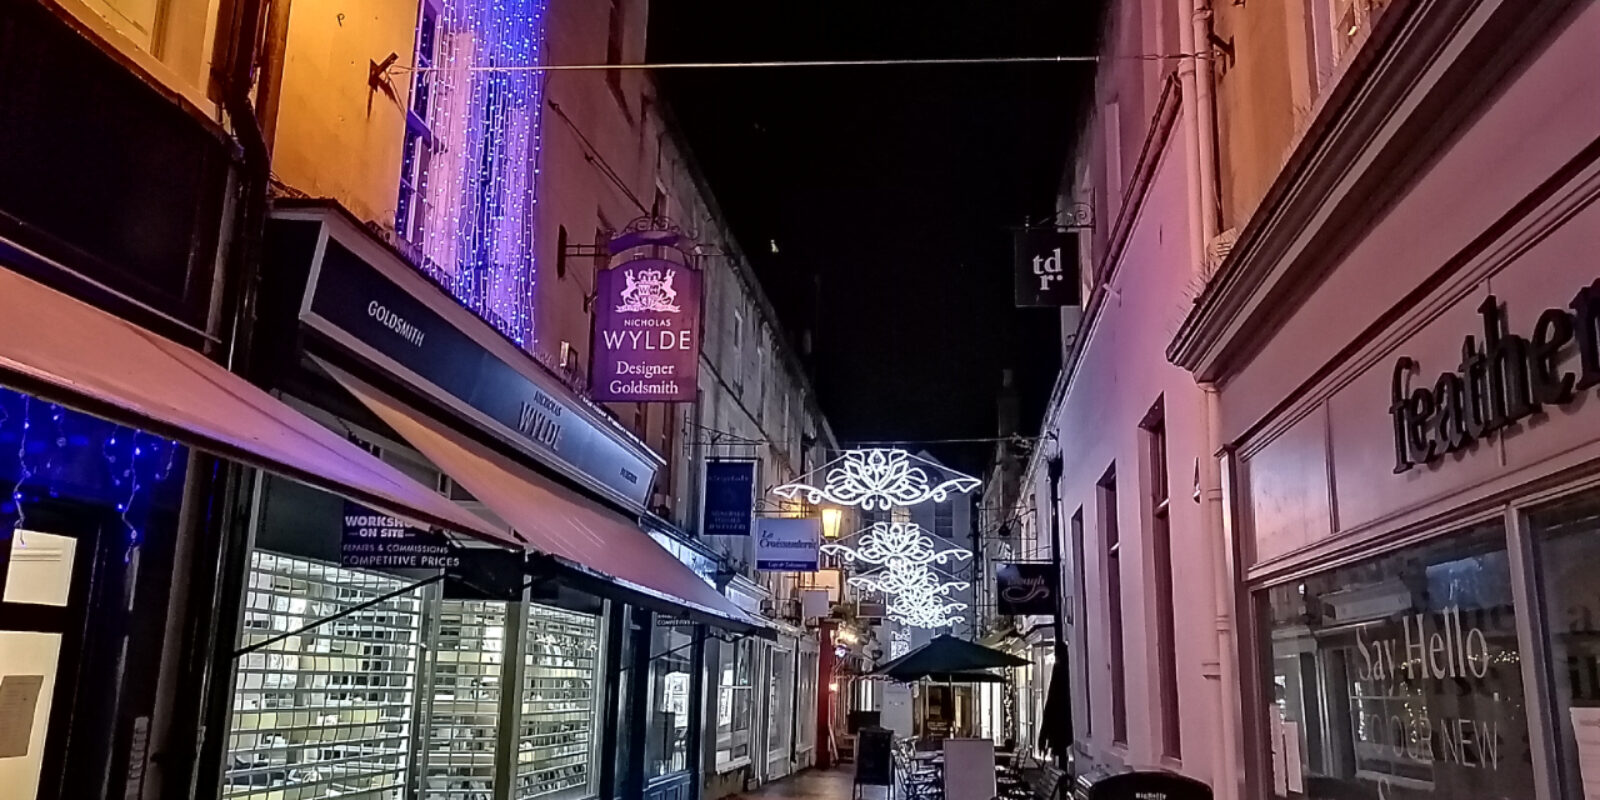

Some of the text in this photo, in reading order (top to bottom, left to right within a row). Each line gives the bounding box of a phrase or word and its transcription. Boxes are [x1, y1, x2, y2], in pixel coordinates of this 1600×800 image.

[1033, 248, 1063, 275] td
[368, 300, 425, 347] GOLDSMITH
[624, 319, 671, 327] NICHOLAS
[603, 330, 691, 350] WYLDE
[616, 361, 674, 378] Designer
[610, 380, 678, 394] Goldsmith
[518, 401, 562, 451] WYLDE
[359, 528, 404, 538] ON SITE
[386, 544, 449, 555] COMMISSIONS
[343, 555, 460, 567] COMPETITIVE PRICES
[1355, 626, 1396, 699] Say
[1402, 606, 1489, 680] Hello
[1392, 714, 1436, 762] OUR
[1440, 718, 1498, 772] NEW
